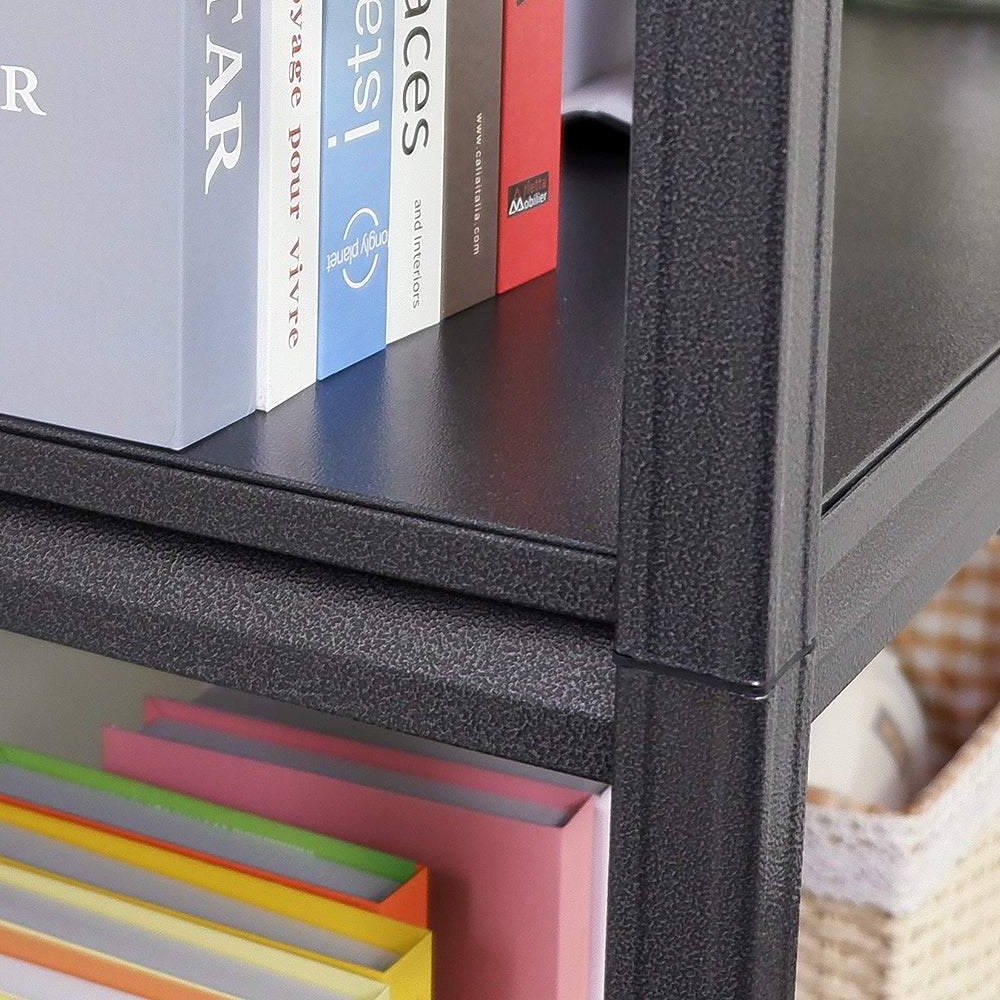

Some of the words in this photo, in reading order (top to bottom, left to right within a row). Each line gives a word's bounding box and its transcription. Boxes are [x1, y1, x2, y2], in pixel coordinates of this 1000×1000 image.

[287, 124, 302, 221] pour
[412, 198, 422, 231] and
[473, 112, 483, 256] www.caliaitalia.com
[286, 236, 303, 350] vivre
[326, 237, 359, 272] planet
[410, 234, 422, 310] Interiors
